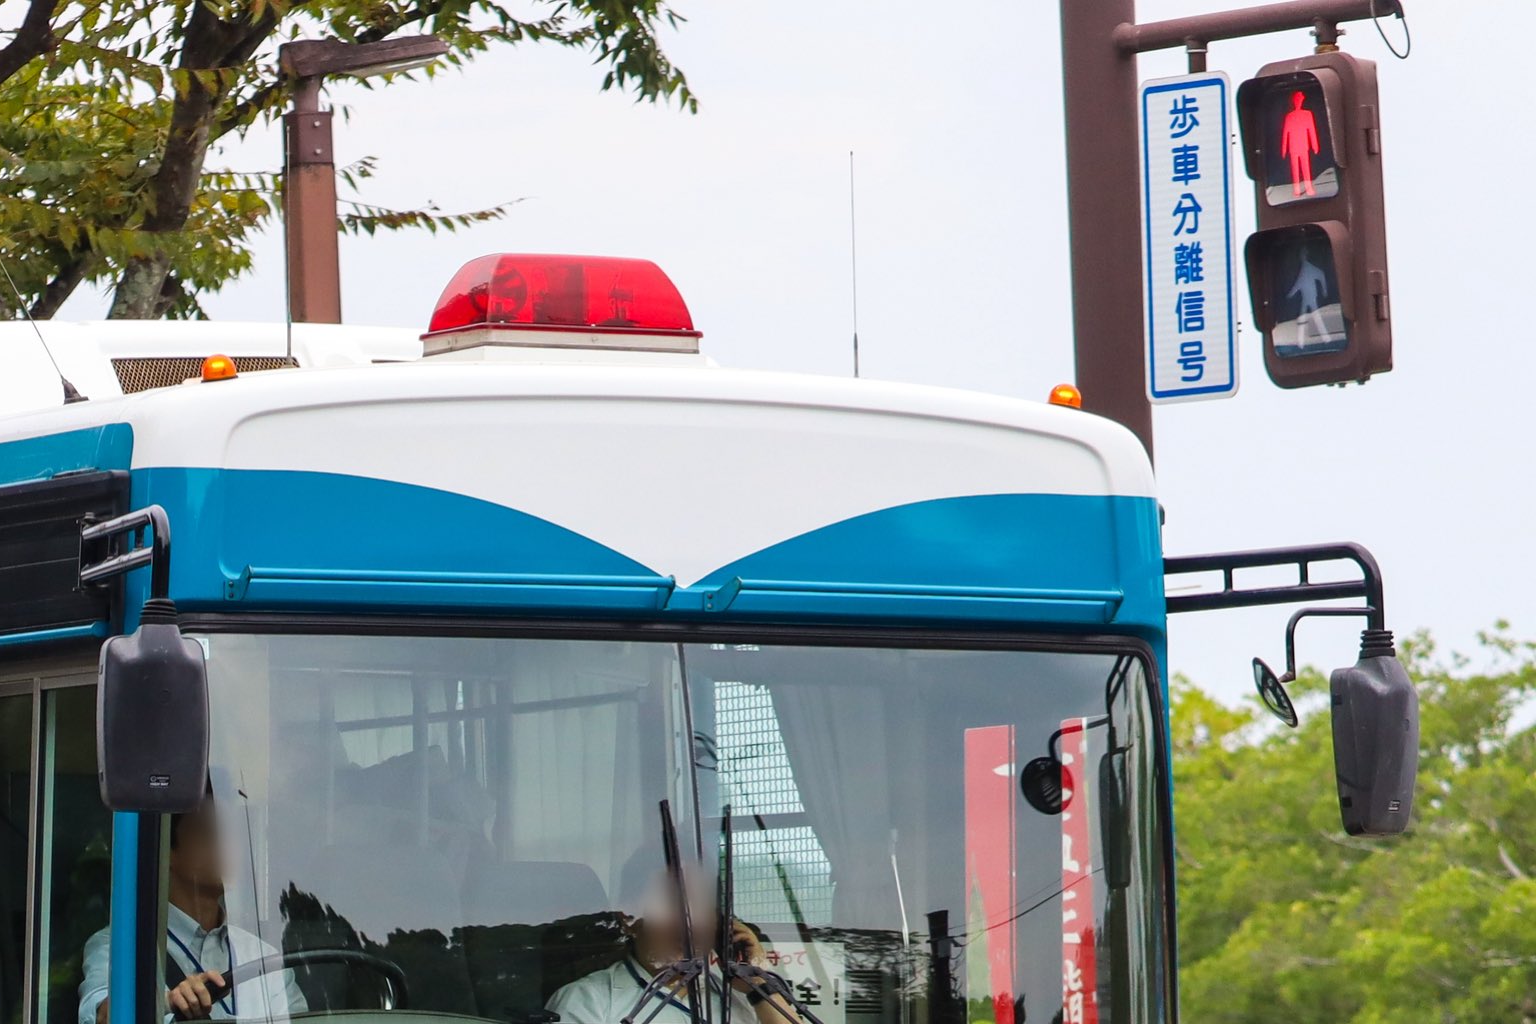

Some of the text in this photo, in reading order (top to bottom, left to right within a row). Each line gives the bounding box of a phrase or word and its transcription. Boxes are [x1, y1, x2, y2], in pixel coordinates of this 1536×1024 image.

[1169, 94, 1207, 383] 歩車分離信号
